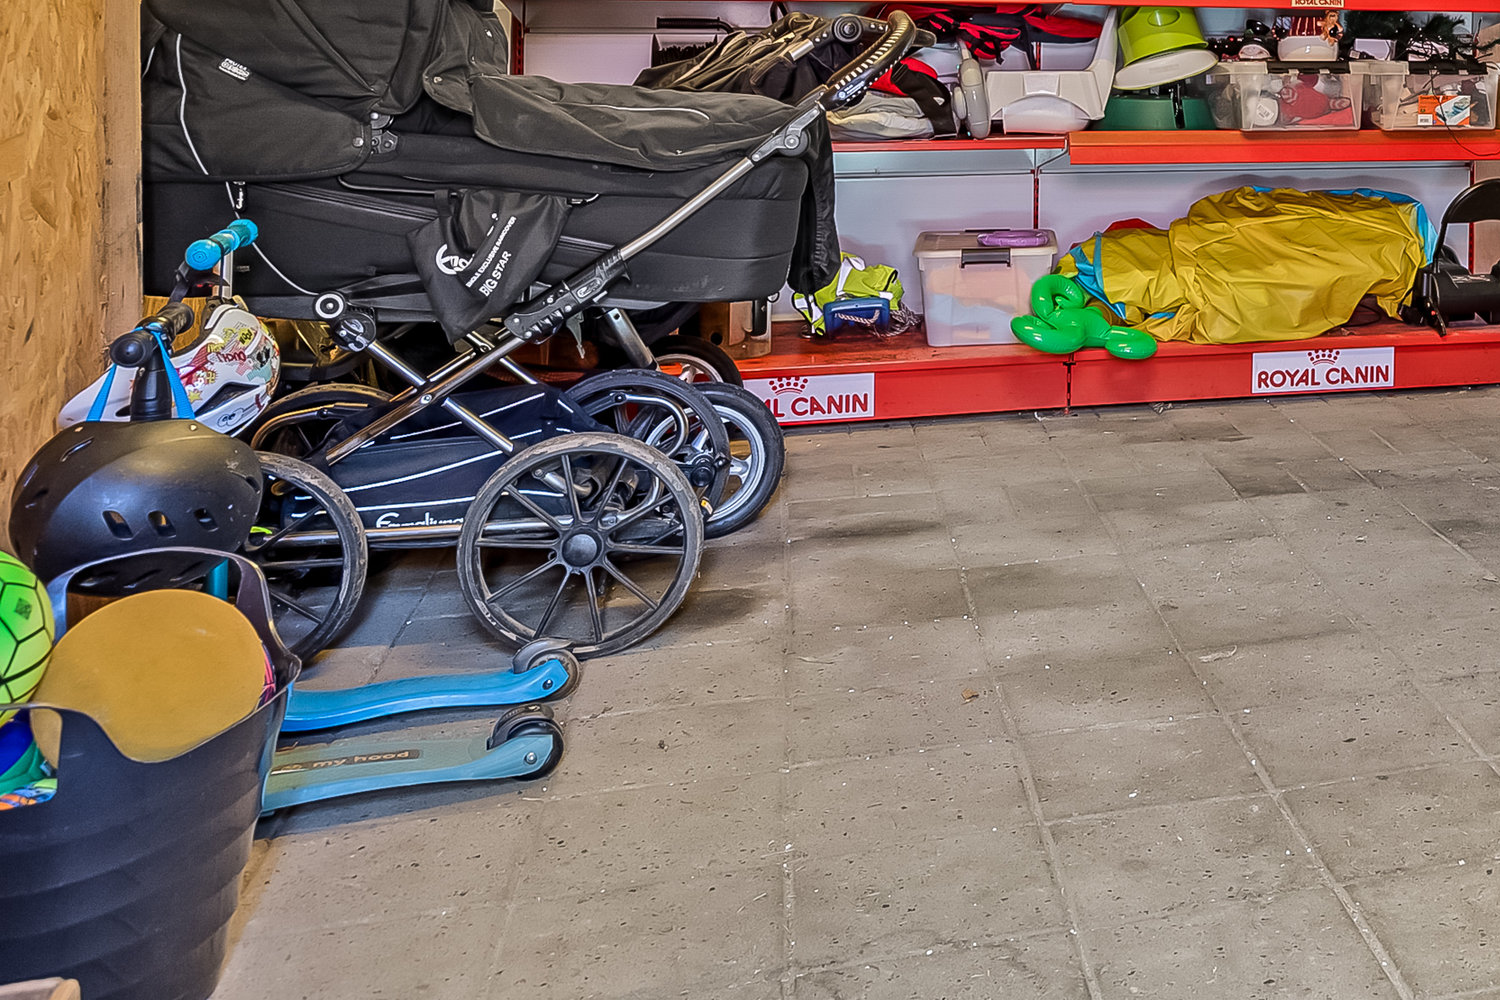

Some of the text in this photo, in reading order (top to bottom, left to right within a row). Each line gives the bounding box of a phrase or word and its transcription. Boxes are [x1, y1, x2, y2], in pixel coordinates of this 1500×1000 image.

[479, 250, 512, 297] BIG STAR
[1257, 365, 1389, 389] ROYAL CANIN
[791, 393, 869, 417] CANIN
[312, 750, 410, 767] my hood
